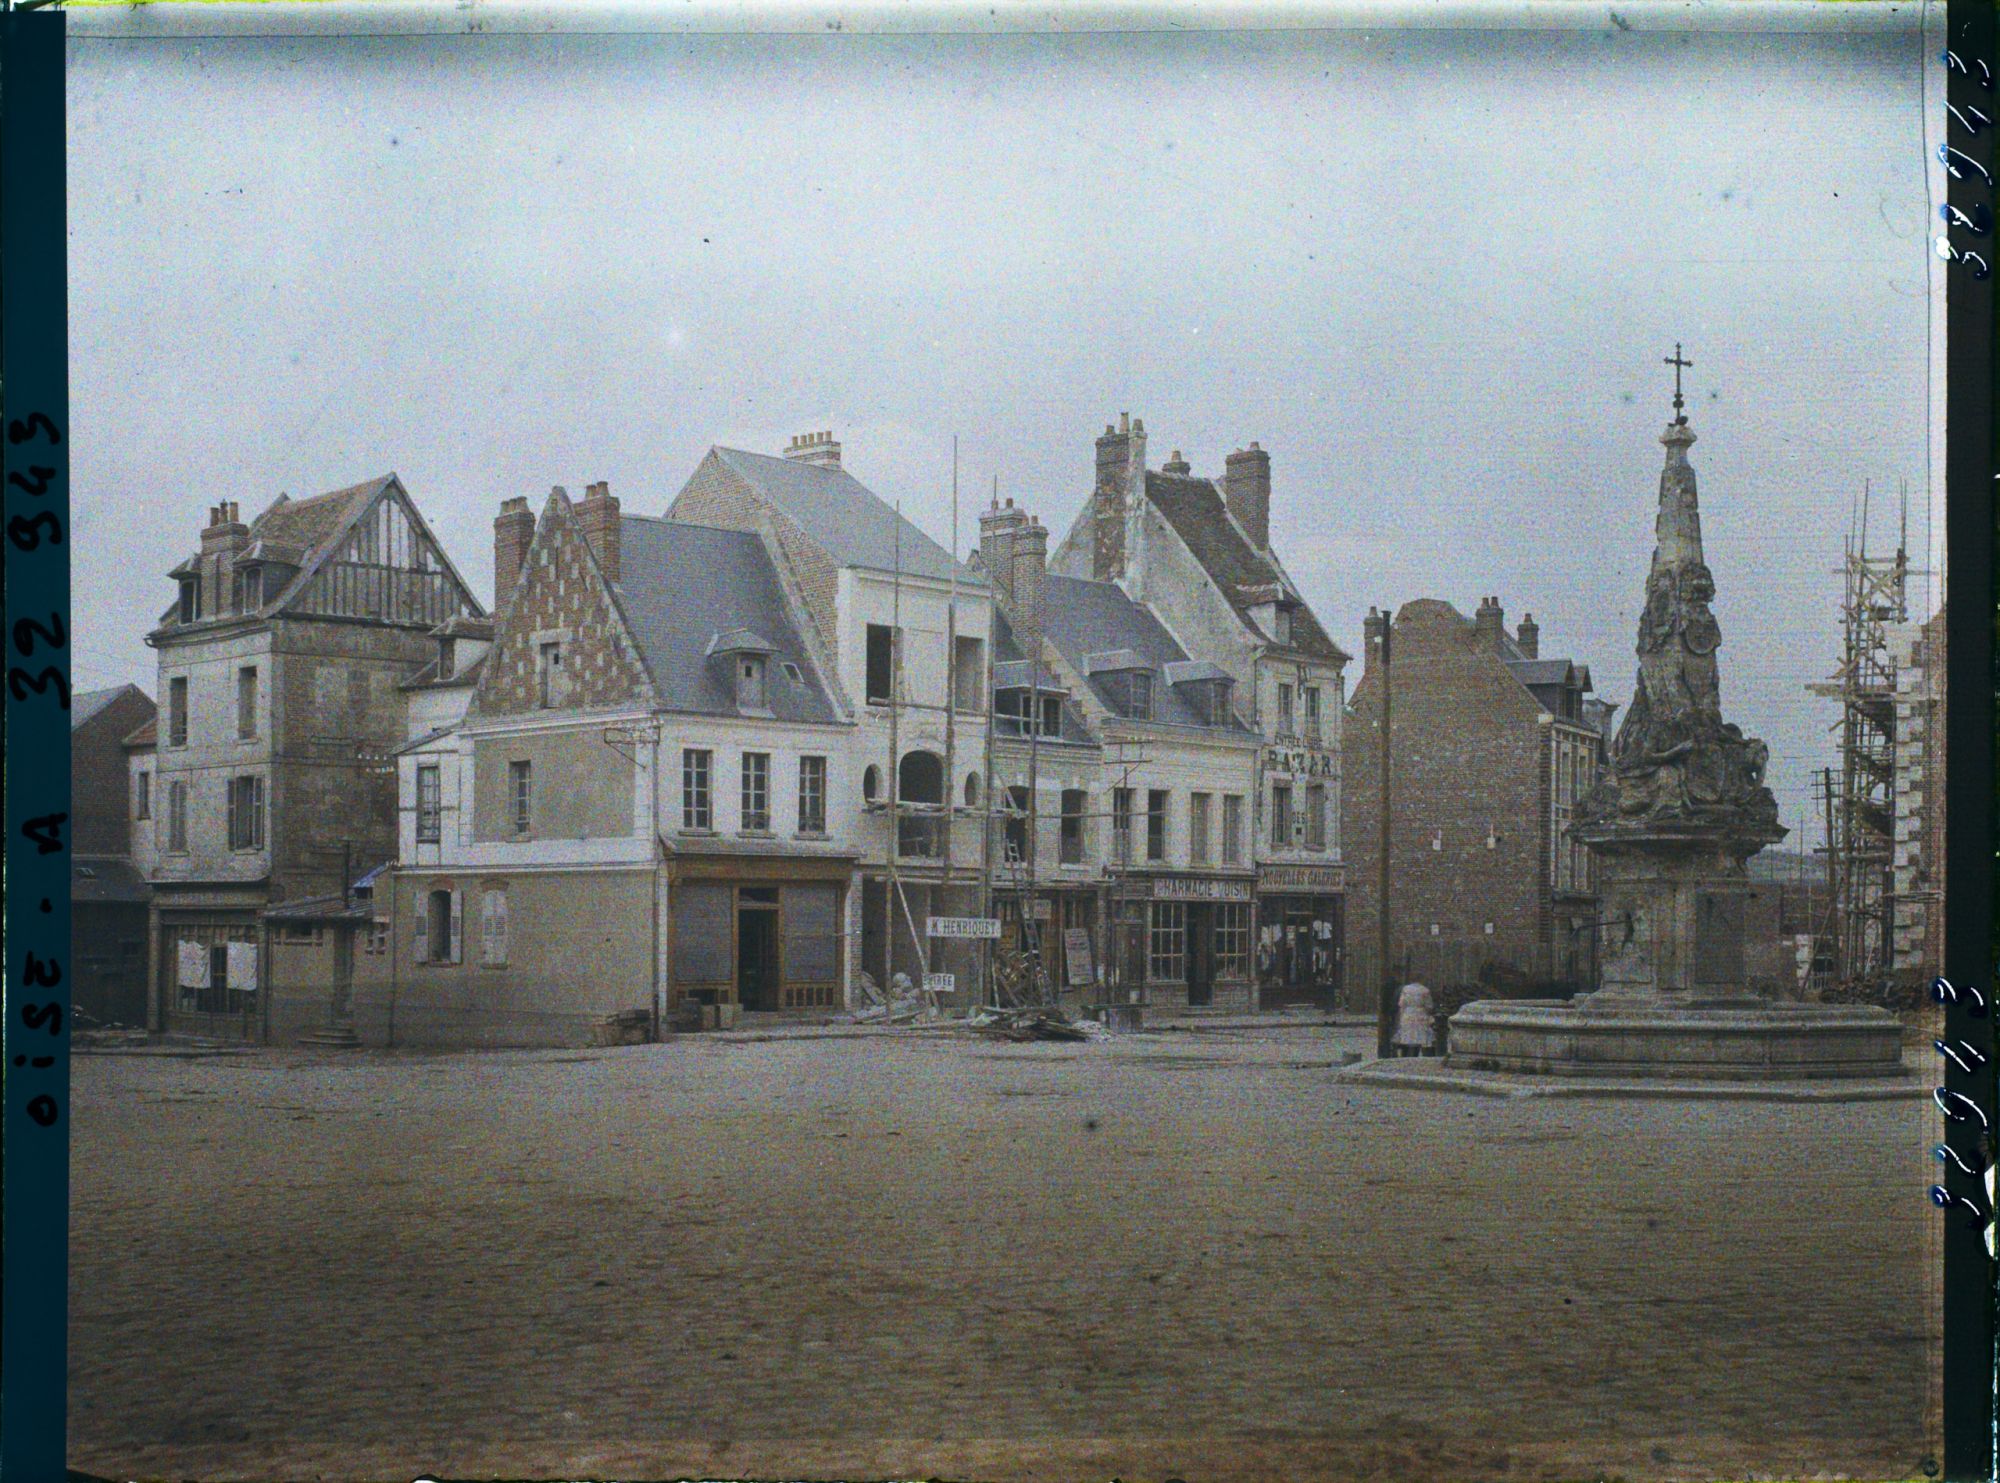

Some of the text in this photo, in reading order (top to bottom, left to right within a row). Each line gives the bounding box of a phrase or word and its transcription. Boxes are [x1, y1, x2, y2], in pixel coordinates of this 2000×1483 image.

[1262, 868, 1342, 887] NOUVELLES GALERIES
[1155, 878, 1213, 897] PHARMACIE
